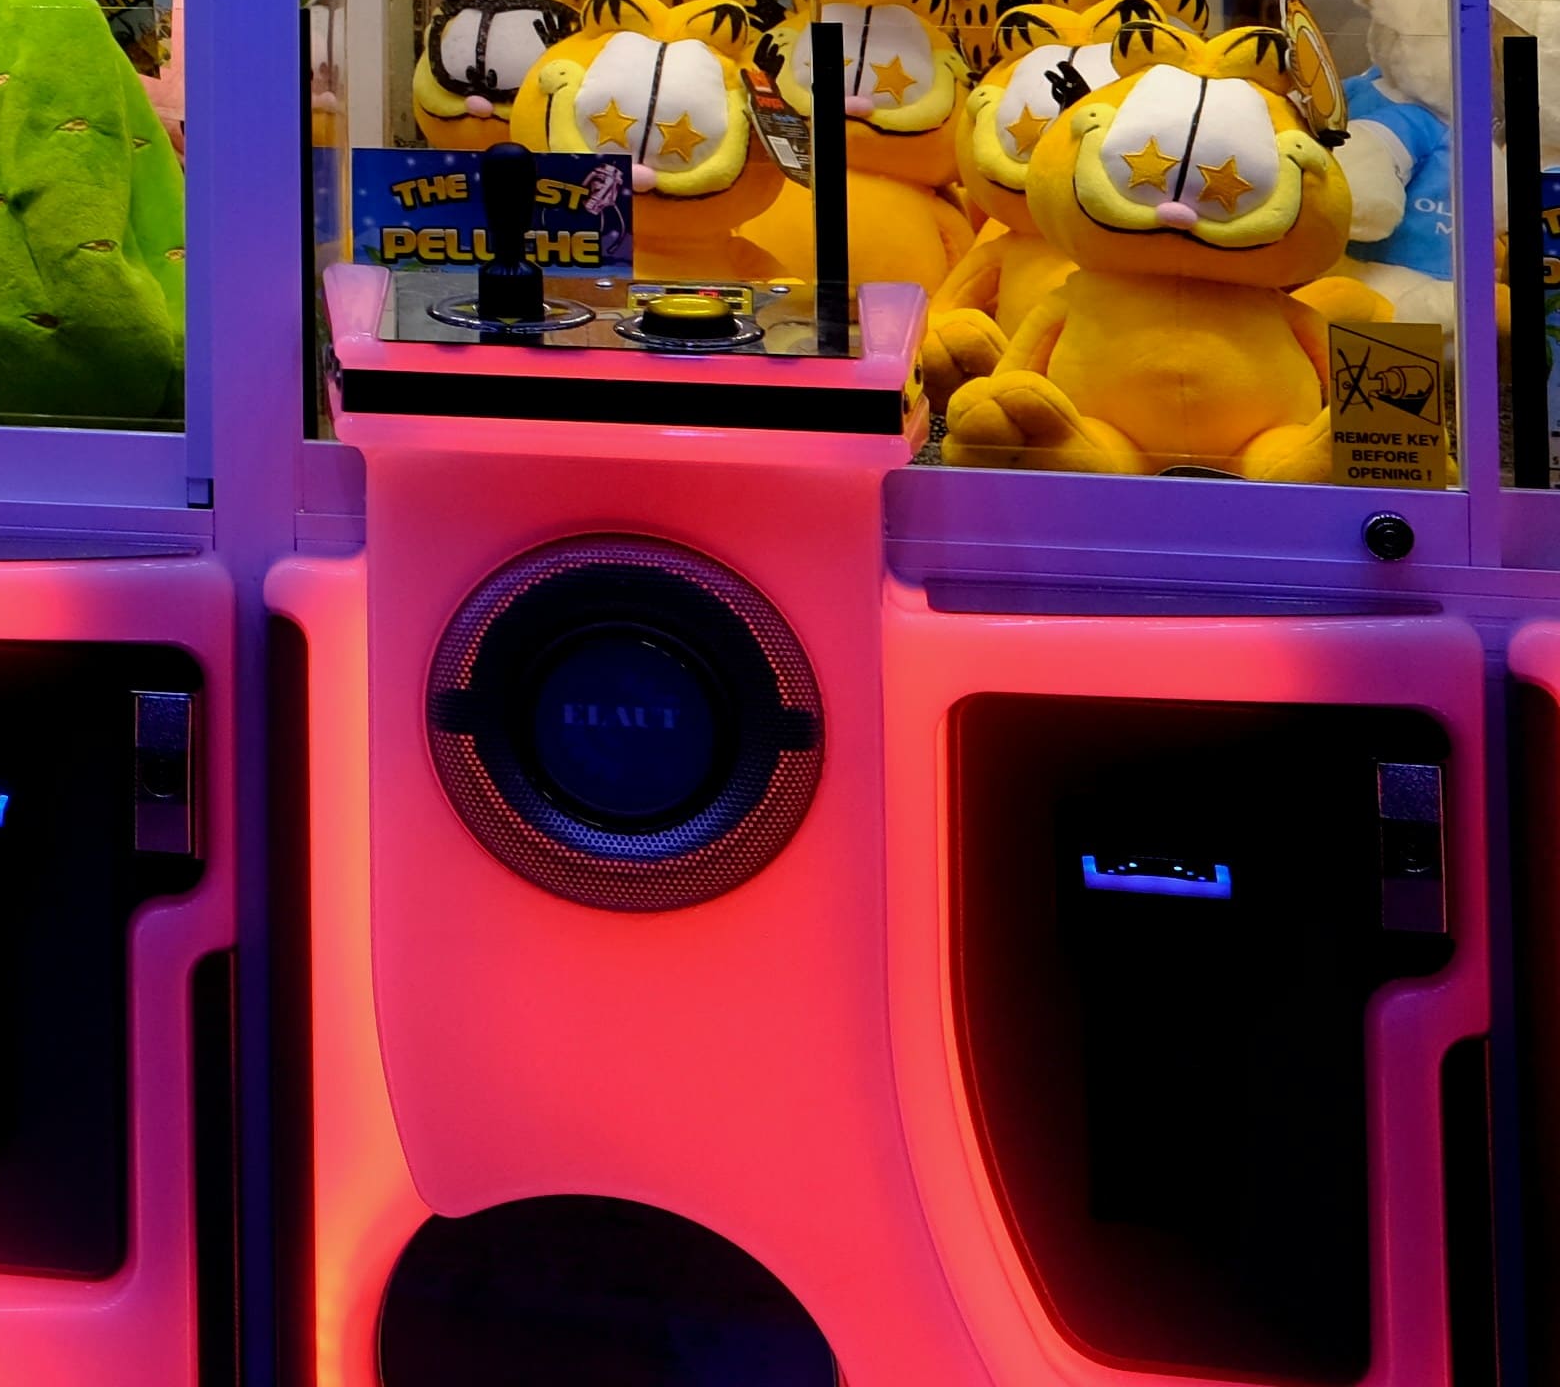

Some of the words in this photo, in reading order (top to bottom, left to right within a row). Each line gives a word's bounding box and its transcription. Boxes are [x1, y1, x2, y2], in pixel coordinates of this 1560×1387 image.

[392, 174, 469, 208] THE
[535, 178, 589, 210] ST
[1334, 431, 1402, 446] REMOVE
[1407, 433, 1440, 447] KEY
[1352, 449, 1419, 464] BEFORE
[1348, 466, 1423, 482] OPENING
